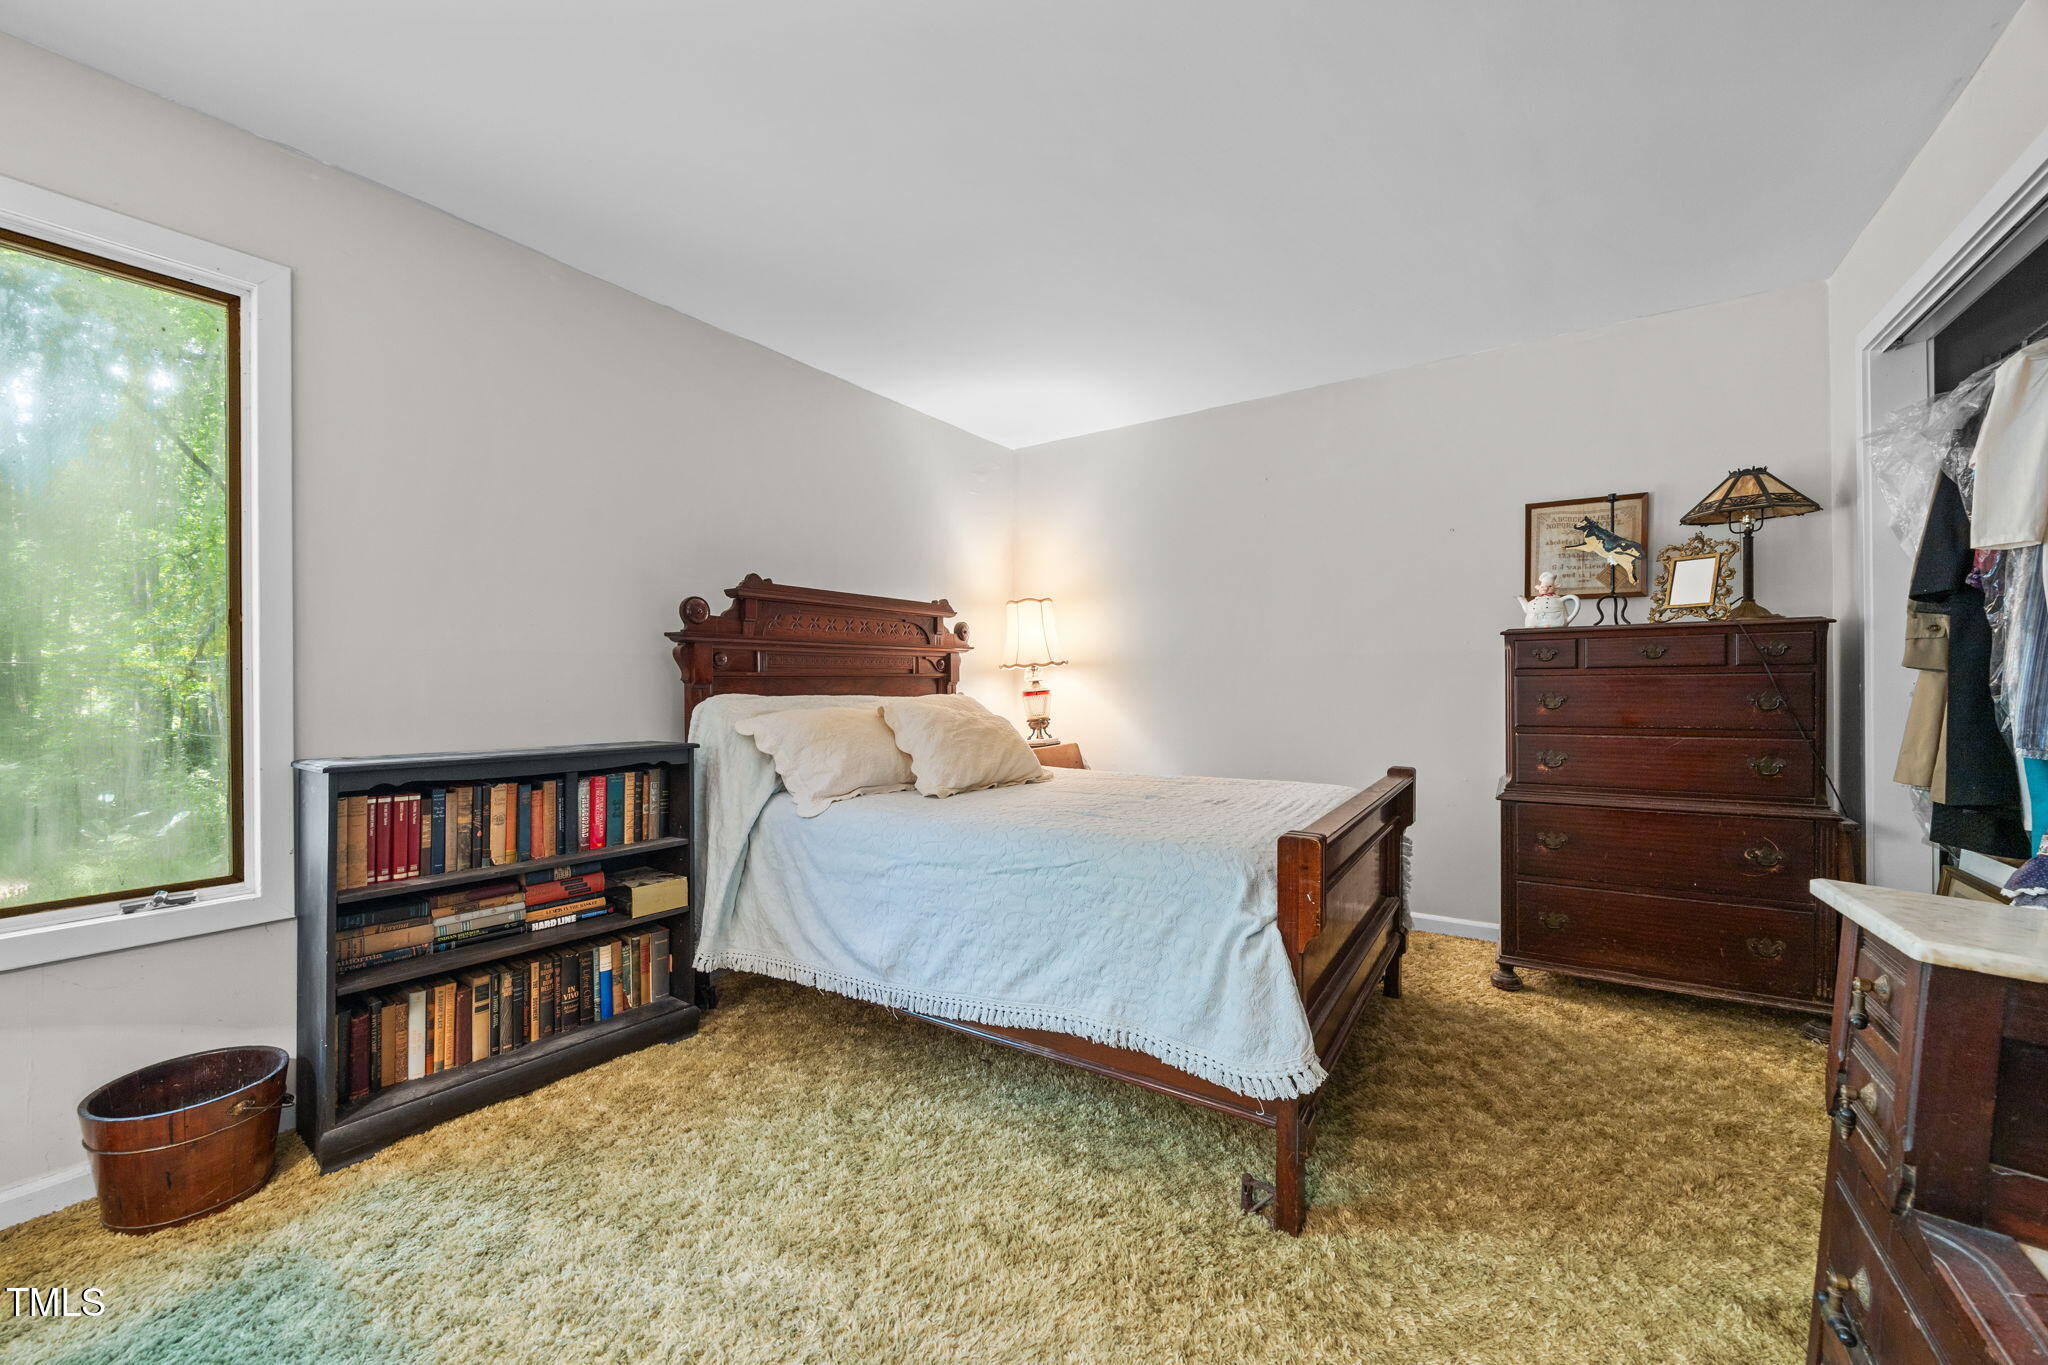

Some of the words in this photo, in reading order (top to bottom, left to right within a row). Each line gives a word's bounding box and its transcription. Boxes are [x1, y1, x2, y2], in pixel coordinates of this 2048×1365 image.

[581, 809, 589, 838] LEOPARD
[531, 918, 557, 931] HARD
[557, 914, 577, 926] LINE
[563, 990, 579, 1000] VIVO
[567, 985, 576, 993] IN
